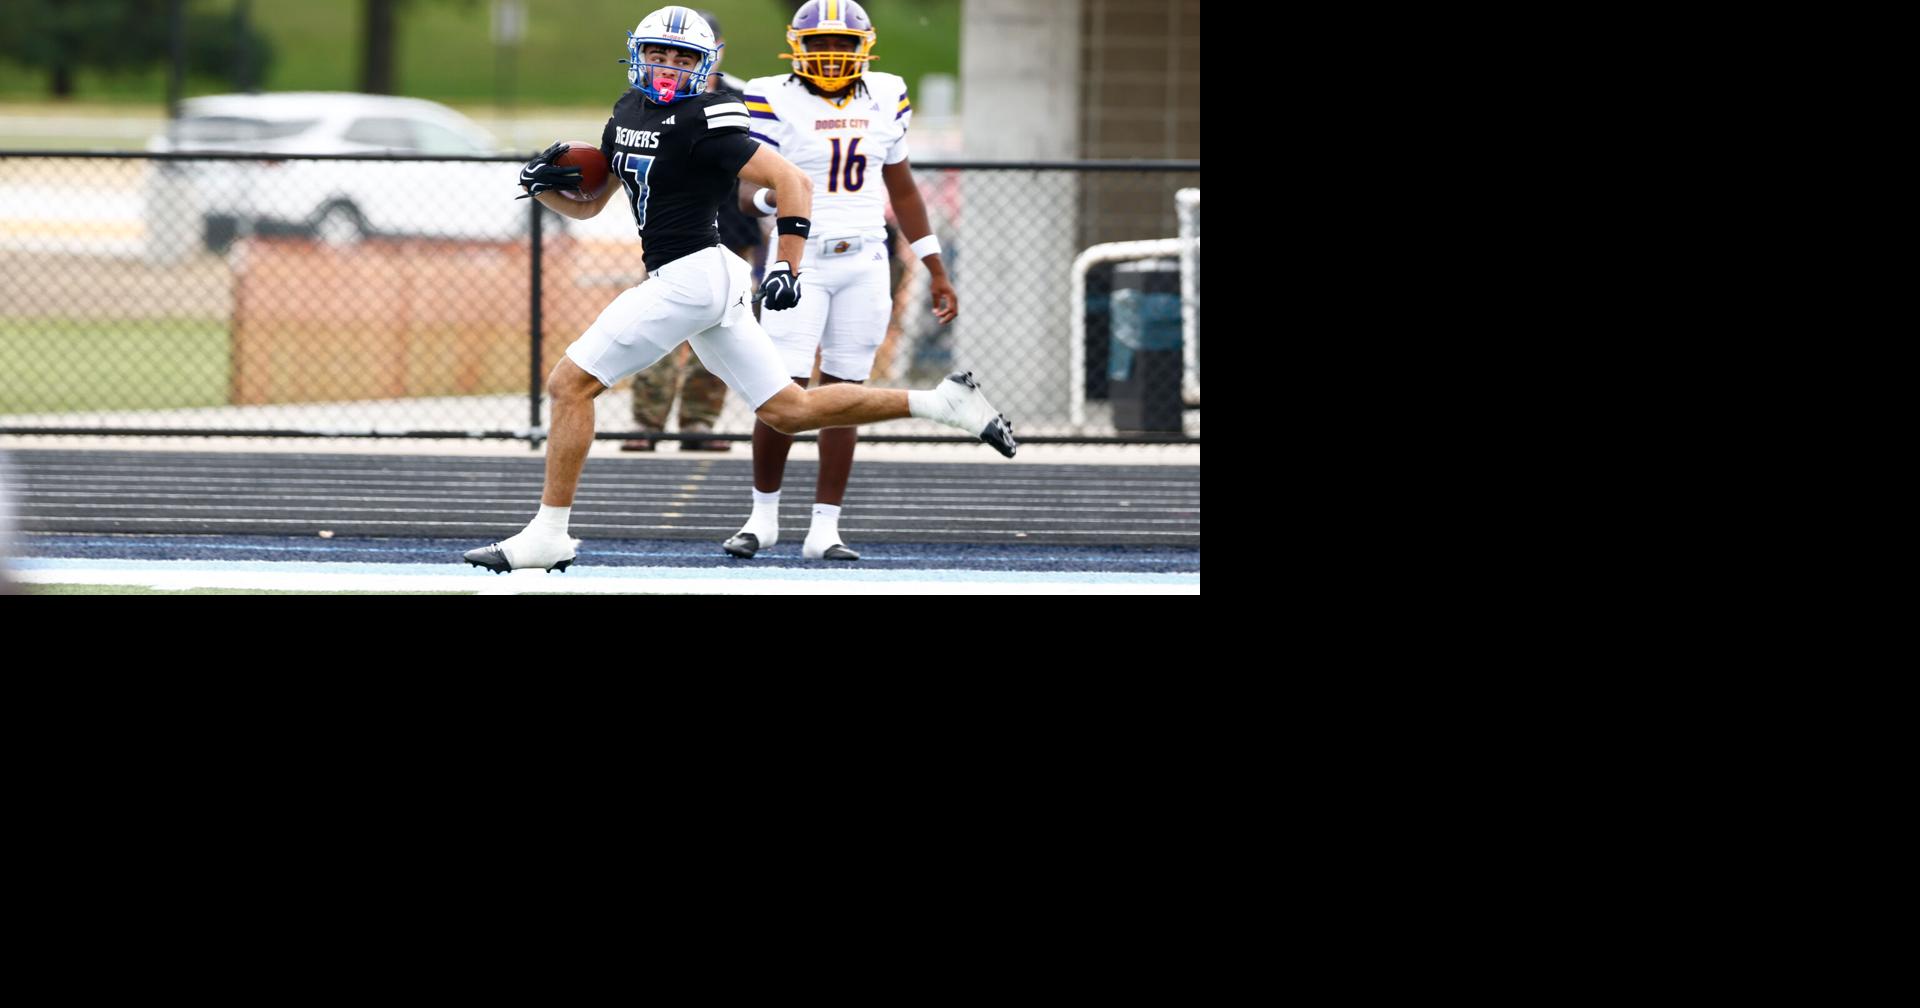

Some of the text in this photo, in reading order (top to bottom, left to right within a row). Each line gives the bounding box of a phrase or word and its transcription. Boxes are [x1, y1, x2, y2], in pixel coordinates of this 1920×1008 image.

[815, 118, 870, 131] DODGE CITY
[614, 126, 661, 149] REIVERS
[828, 136, 867, 193] 16
